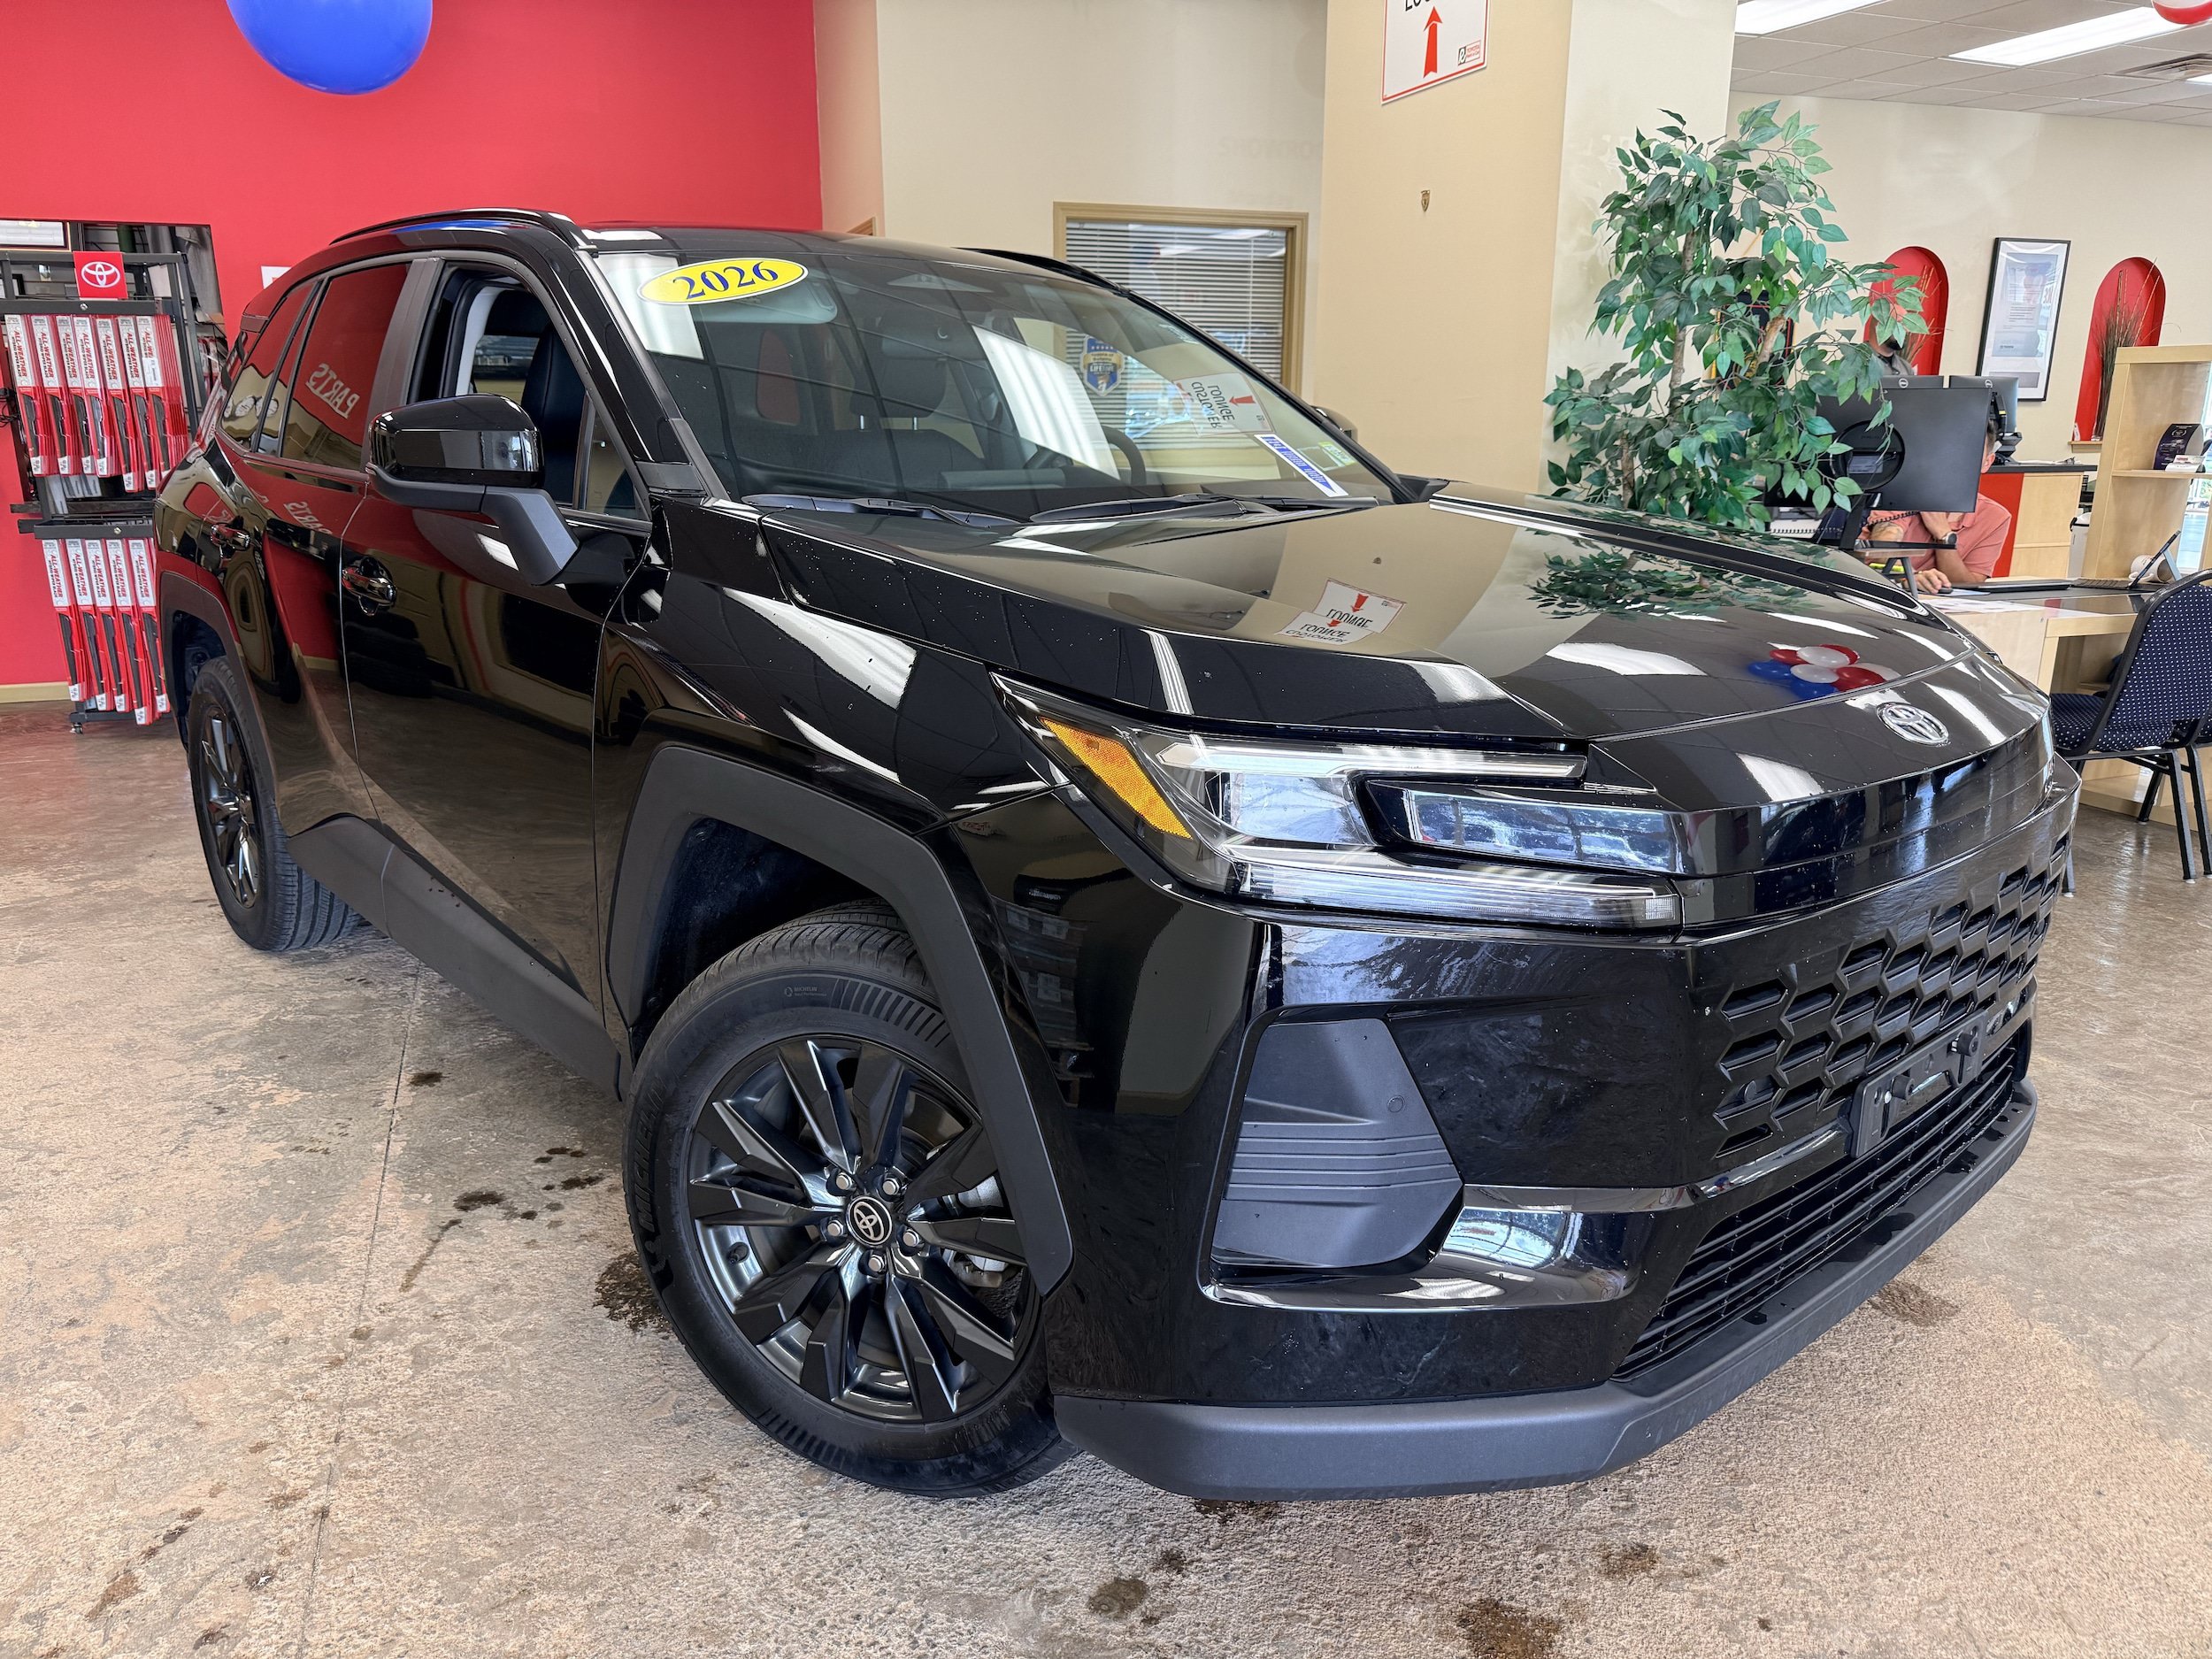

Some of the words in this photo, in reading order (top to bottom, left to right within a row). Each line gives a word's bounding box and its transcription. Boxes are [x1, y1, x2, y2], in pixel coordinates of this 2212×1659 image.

[672, 261, 779, 299] 2026
[13, 330, 27, 376] ALL-WEATHER
[40, 332, 54, 377] ALL-WEATHER
[64, 333, 77, 378] ALL-WEATHER
[82, 333, 95, 378] ALL-WEATHER
[104, 334, 117, 379] ALL-WEATHER
[127, 333, 139, 377] ALL-WEATHER
[50, 555, 63, 596] ALL-WEATHER
[74, 553, 88, 595] ALL-WEATHER
[94, 554, 106, 596] ALL-WEATHER
[114, 554, 127, 596] ALL-WEATHER
[137, 555, 150, 596] ALL-WEATHER
